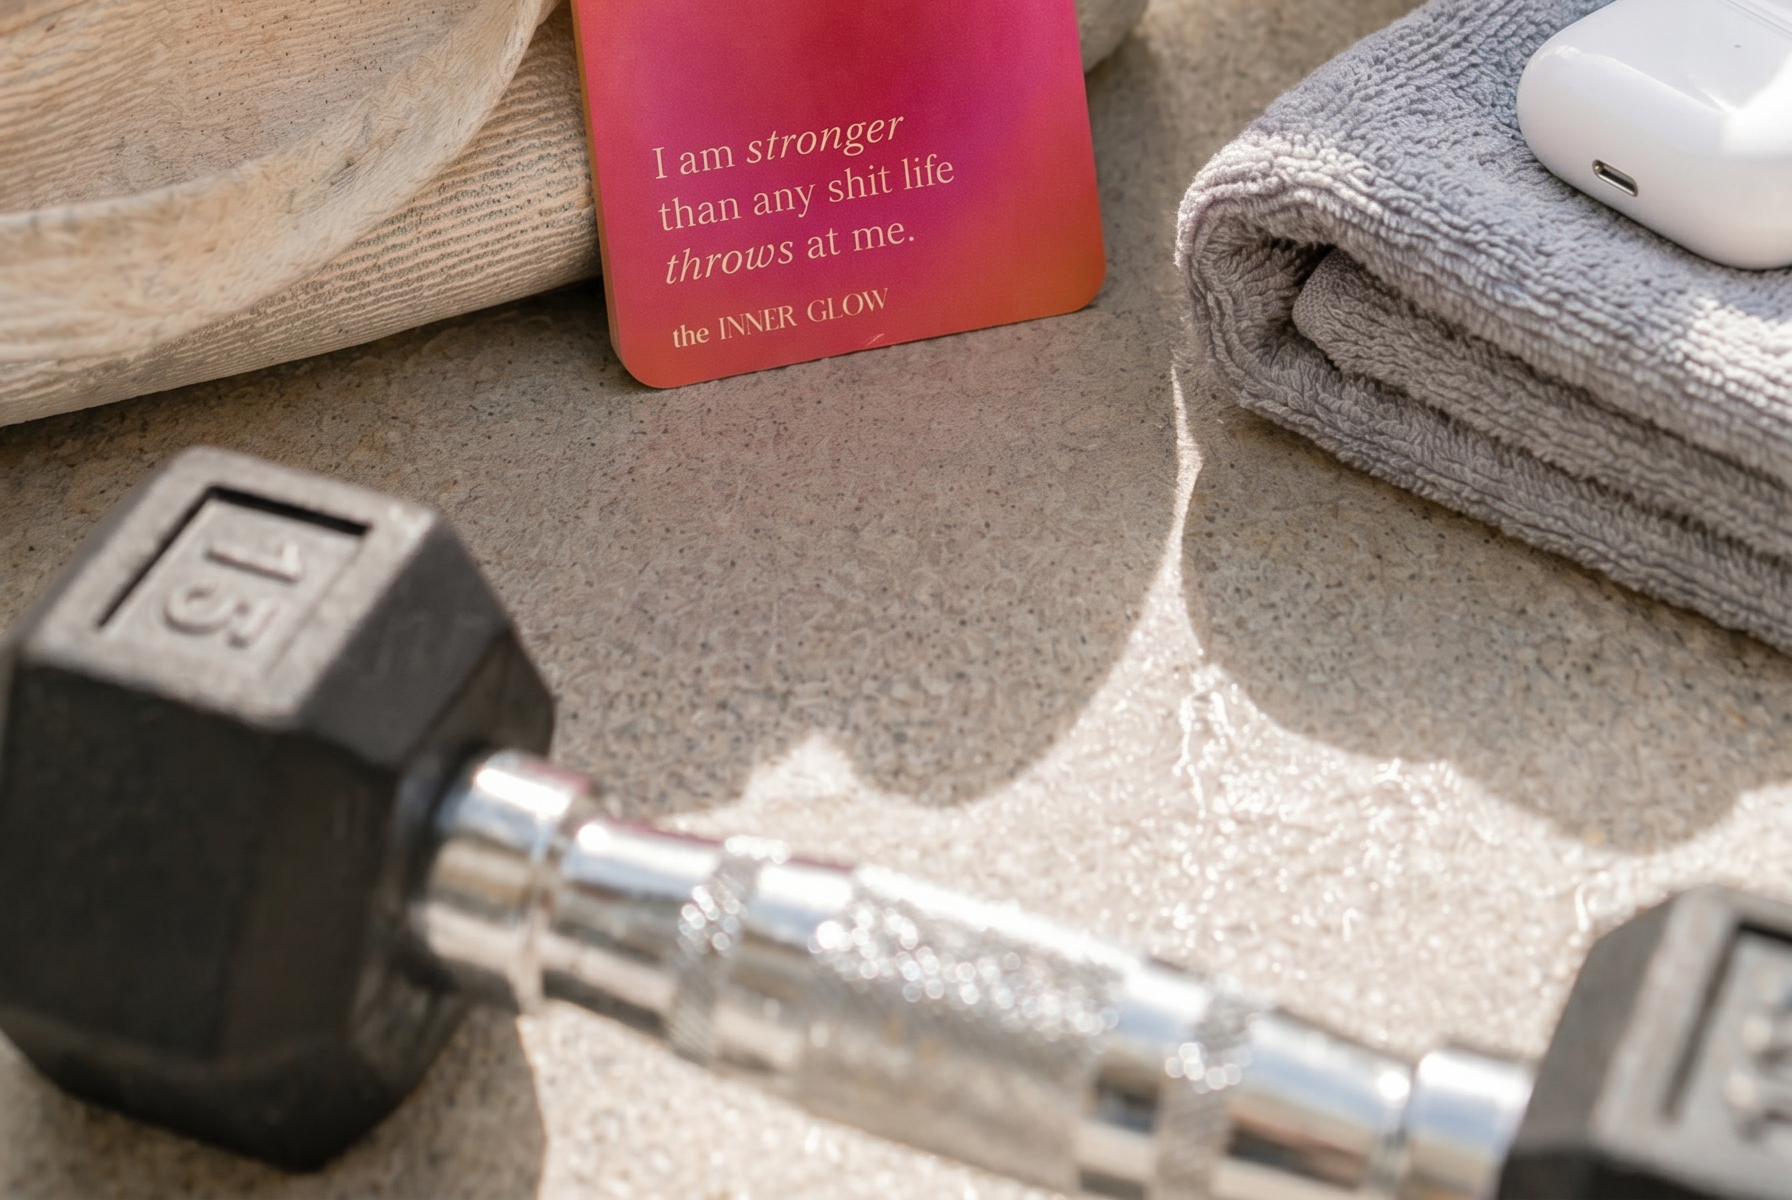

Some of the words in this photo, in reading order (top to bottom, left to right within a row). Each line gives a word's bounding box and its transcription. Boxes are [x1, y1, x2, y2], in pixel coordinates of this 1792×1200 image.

[652, 146, 668, 180] I
[679, 144, 736, 176] am
[746, 116, 904, 165] stronger
[658, 195, 742, 231] than
[753, 183, 816, 218] any
[827, 164, 893, 203] shit
[901, 153, 955, 191] life
[665, 240, 794, 285] throws
[807, 227, 841, 259] at
[851, 221, 916, 253] me.
[672, 325, 710, 349] the
[718, 305, 798, 341] INNER
[806, 288, 889, 323] GLOW
[163, 540, 303, 650] 15
